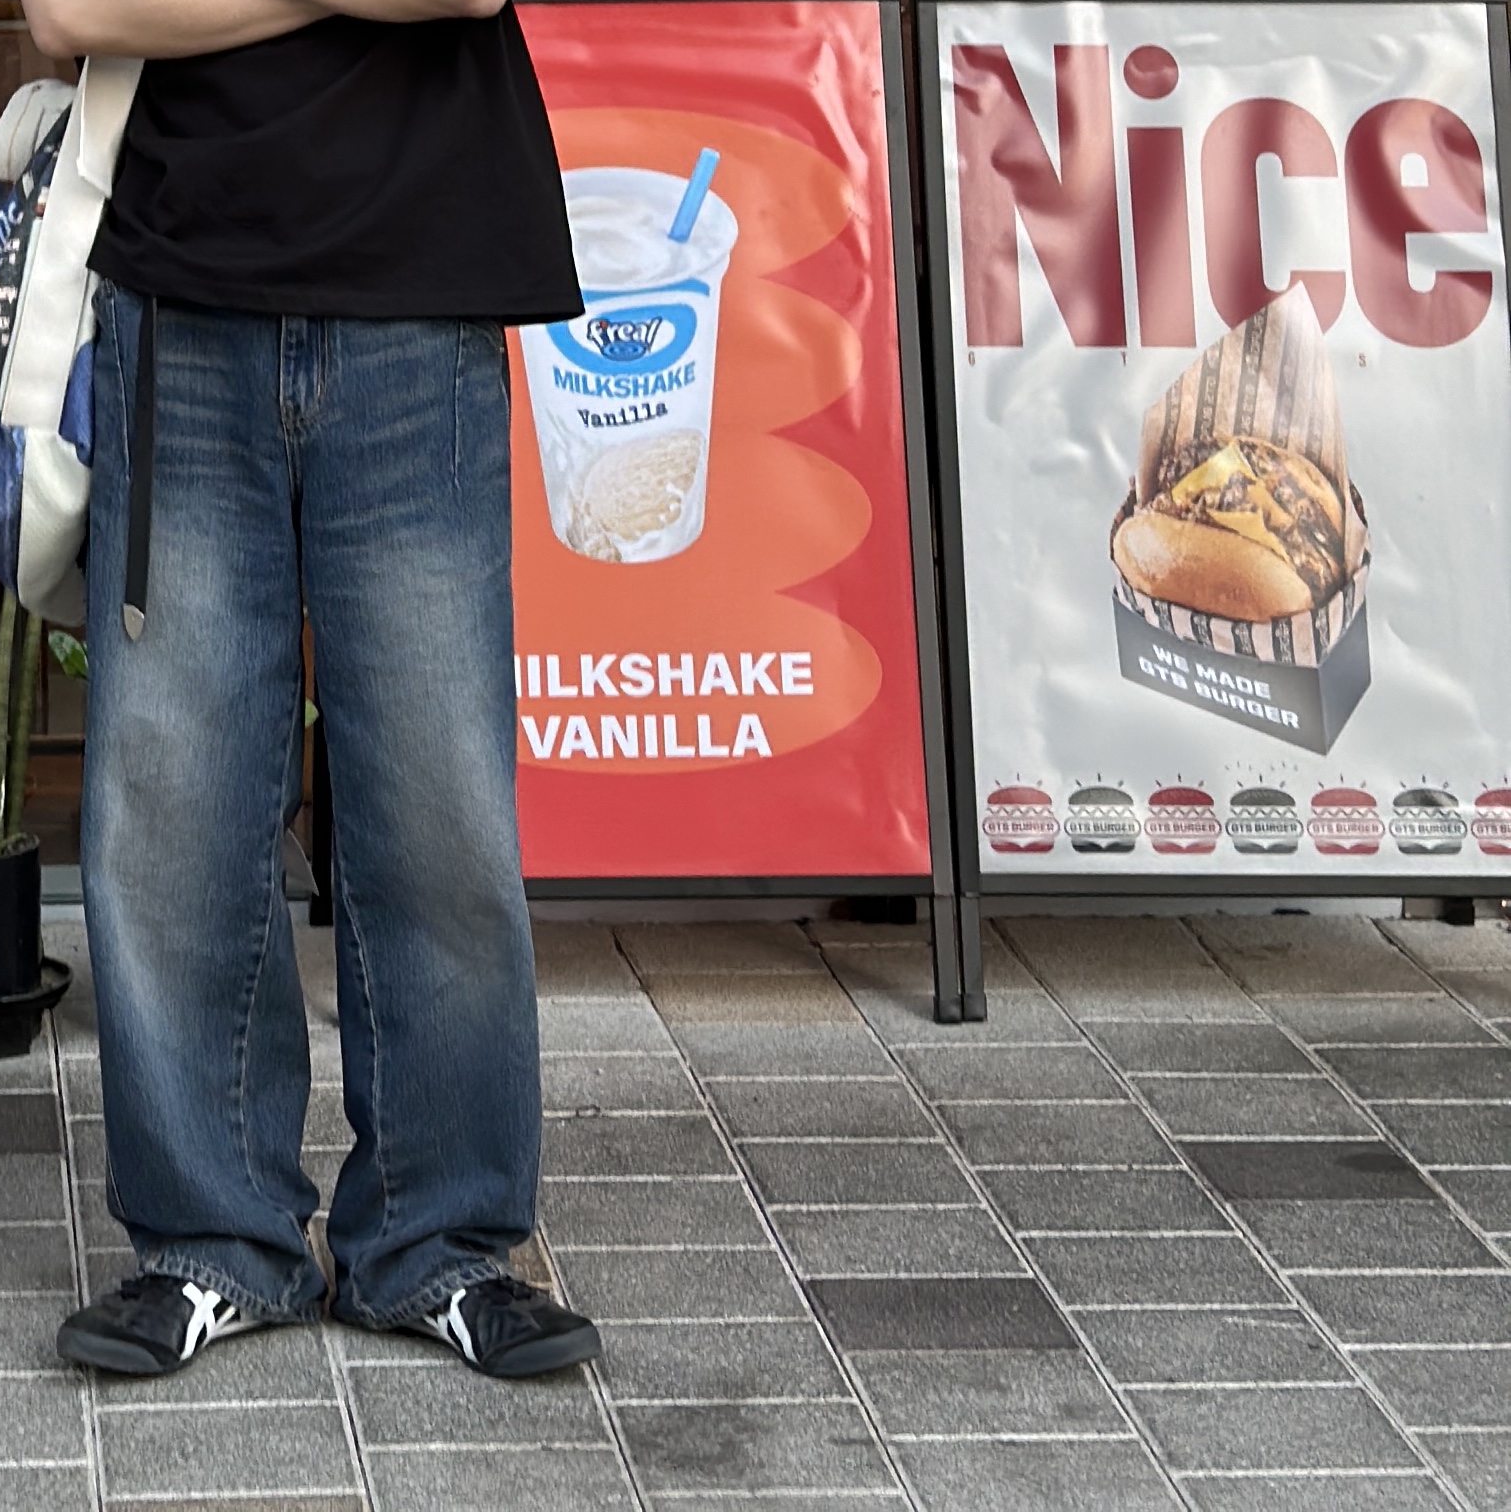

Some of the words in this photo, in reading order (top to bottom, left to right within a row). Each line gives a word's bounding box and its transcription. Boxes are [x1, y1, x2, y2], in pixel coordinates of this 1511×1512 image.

[951, 44, 1493, 348] Nice
[552, 361, 696, 398] MILKSHAKE
[578, 399, 668, 428] Vanilla
[1152, 644, 1189, 673] WE
[1195, 662, 1272, 700] MADE
[1193, 681, 1301, 729] BURGER
[521, 713, 773, 759] VANILLA
